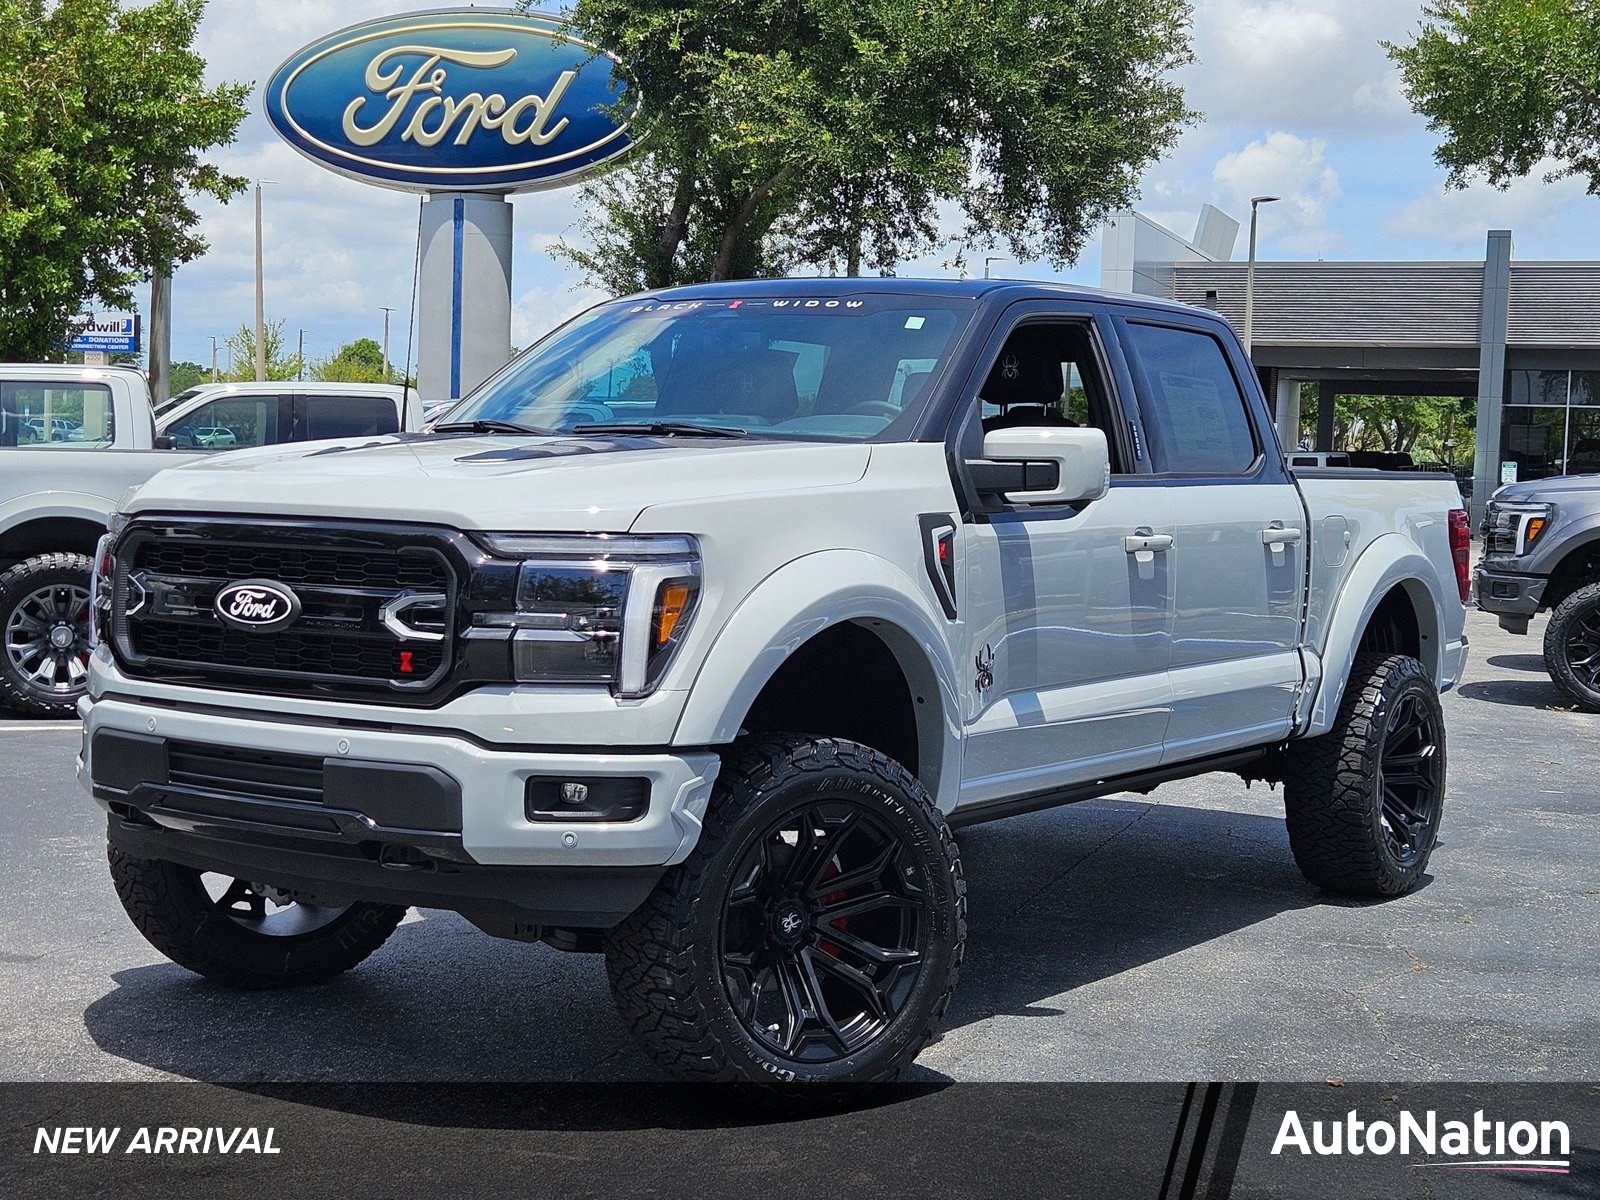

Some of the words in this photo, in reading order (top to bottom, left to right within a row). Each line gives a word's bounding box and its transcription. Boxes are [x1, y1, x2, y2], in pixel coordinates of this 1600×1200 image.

[342, 45, 576, 147] Ford
[629, 301, 703, 314] BLACK
[772, 299, 864, 309] WIDOW
[230, 590, 276, 618] Ford
